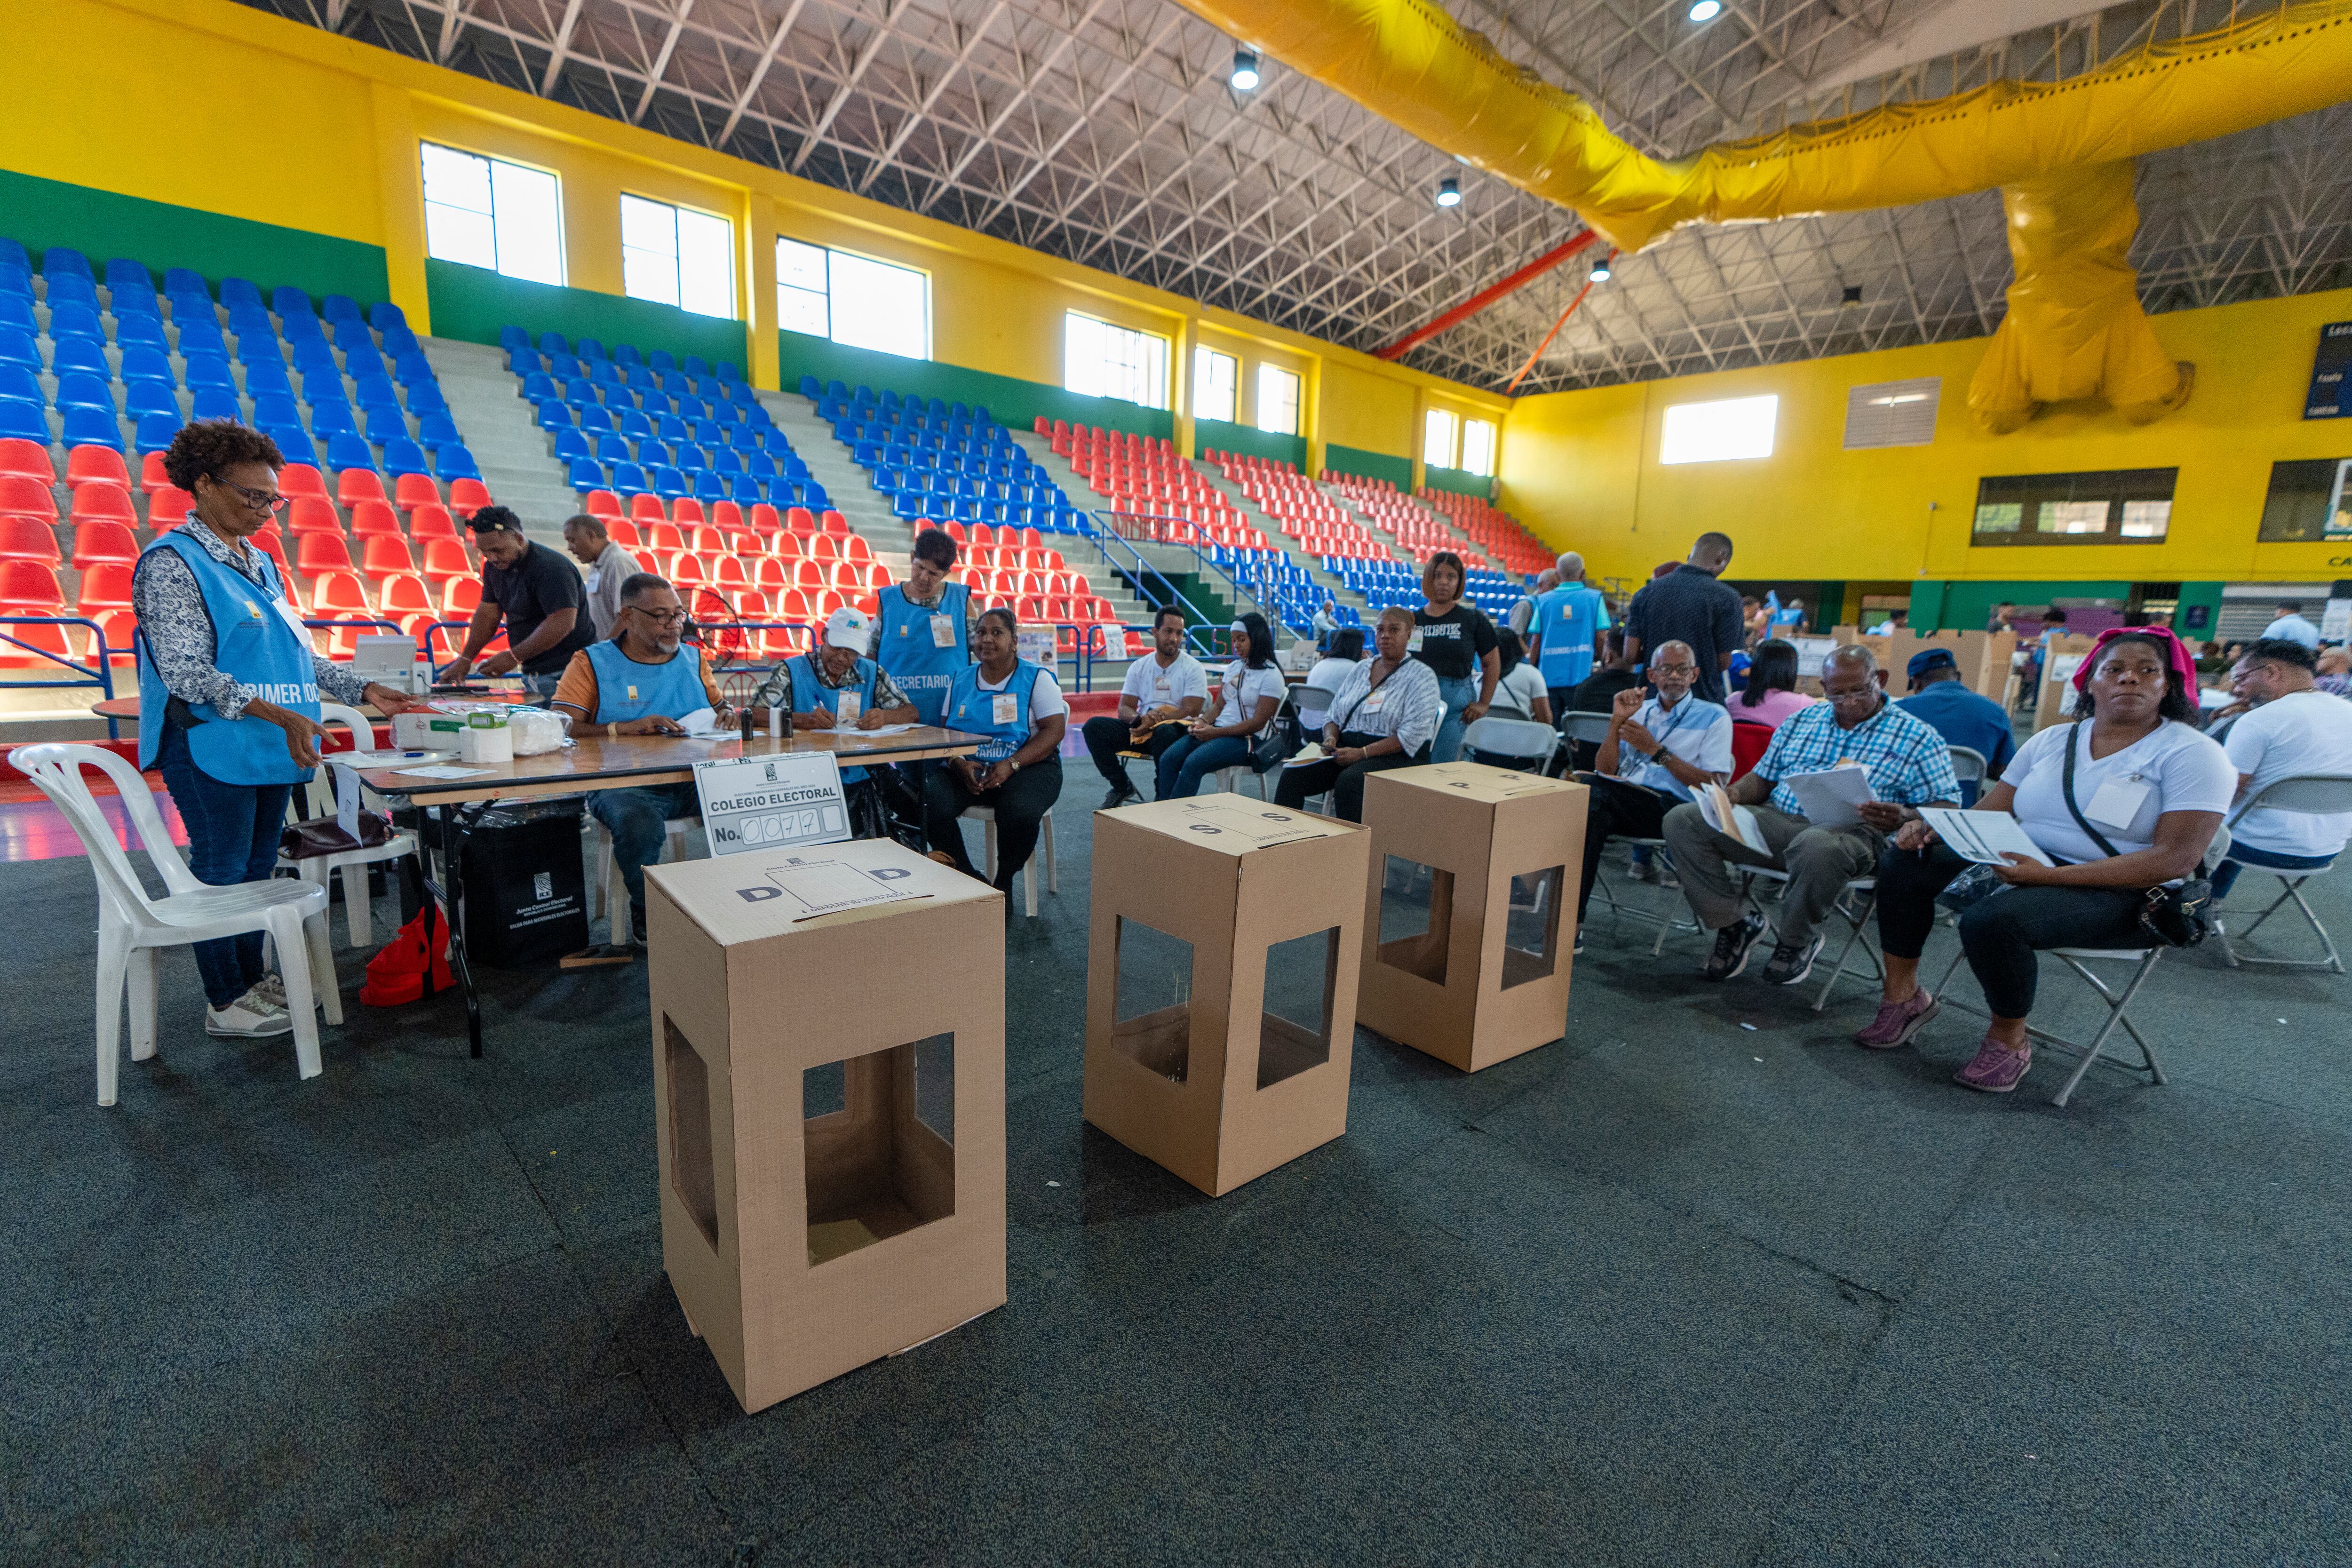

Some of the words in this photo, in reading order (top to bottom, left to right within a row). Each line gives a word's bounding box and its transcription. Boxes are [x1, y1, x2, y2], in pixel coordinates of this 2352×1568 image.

[891, 675, 950, 689] SECRETARIO
[711, 796, 766, 812] COLEGIO
[770, 787, 836, 804] ELECTORAL
[1261, 812, 1293, 822] S
[715, 827, 741, 843] No.
[1189, 824, 1223, 834] S
[868, 868, 912, 881] D
[735, 886, 783, 903] D
[516, 907, 532, 915] Junta
[532, 901, 550, 910] Central
[551, 895, 573, 906] Electoral
[810, 900, 851, 912] DEPOSITE
[533, 913, 556, 923] MATERIALES
[556, 907, 580, 918] ELECTORALES
